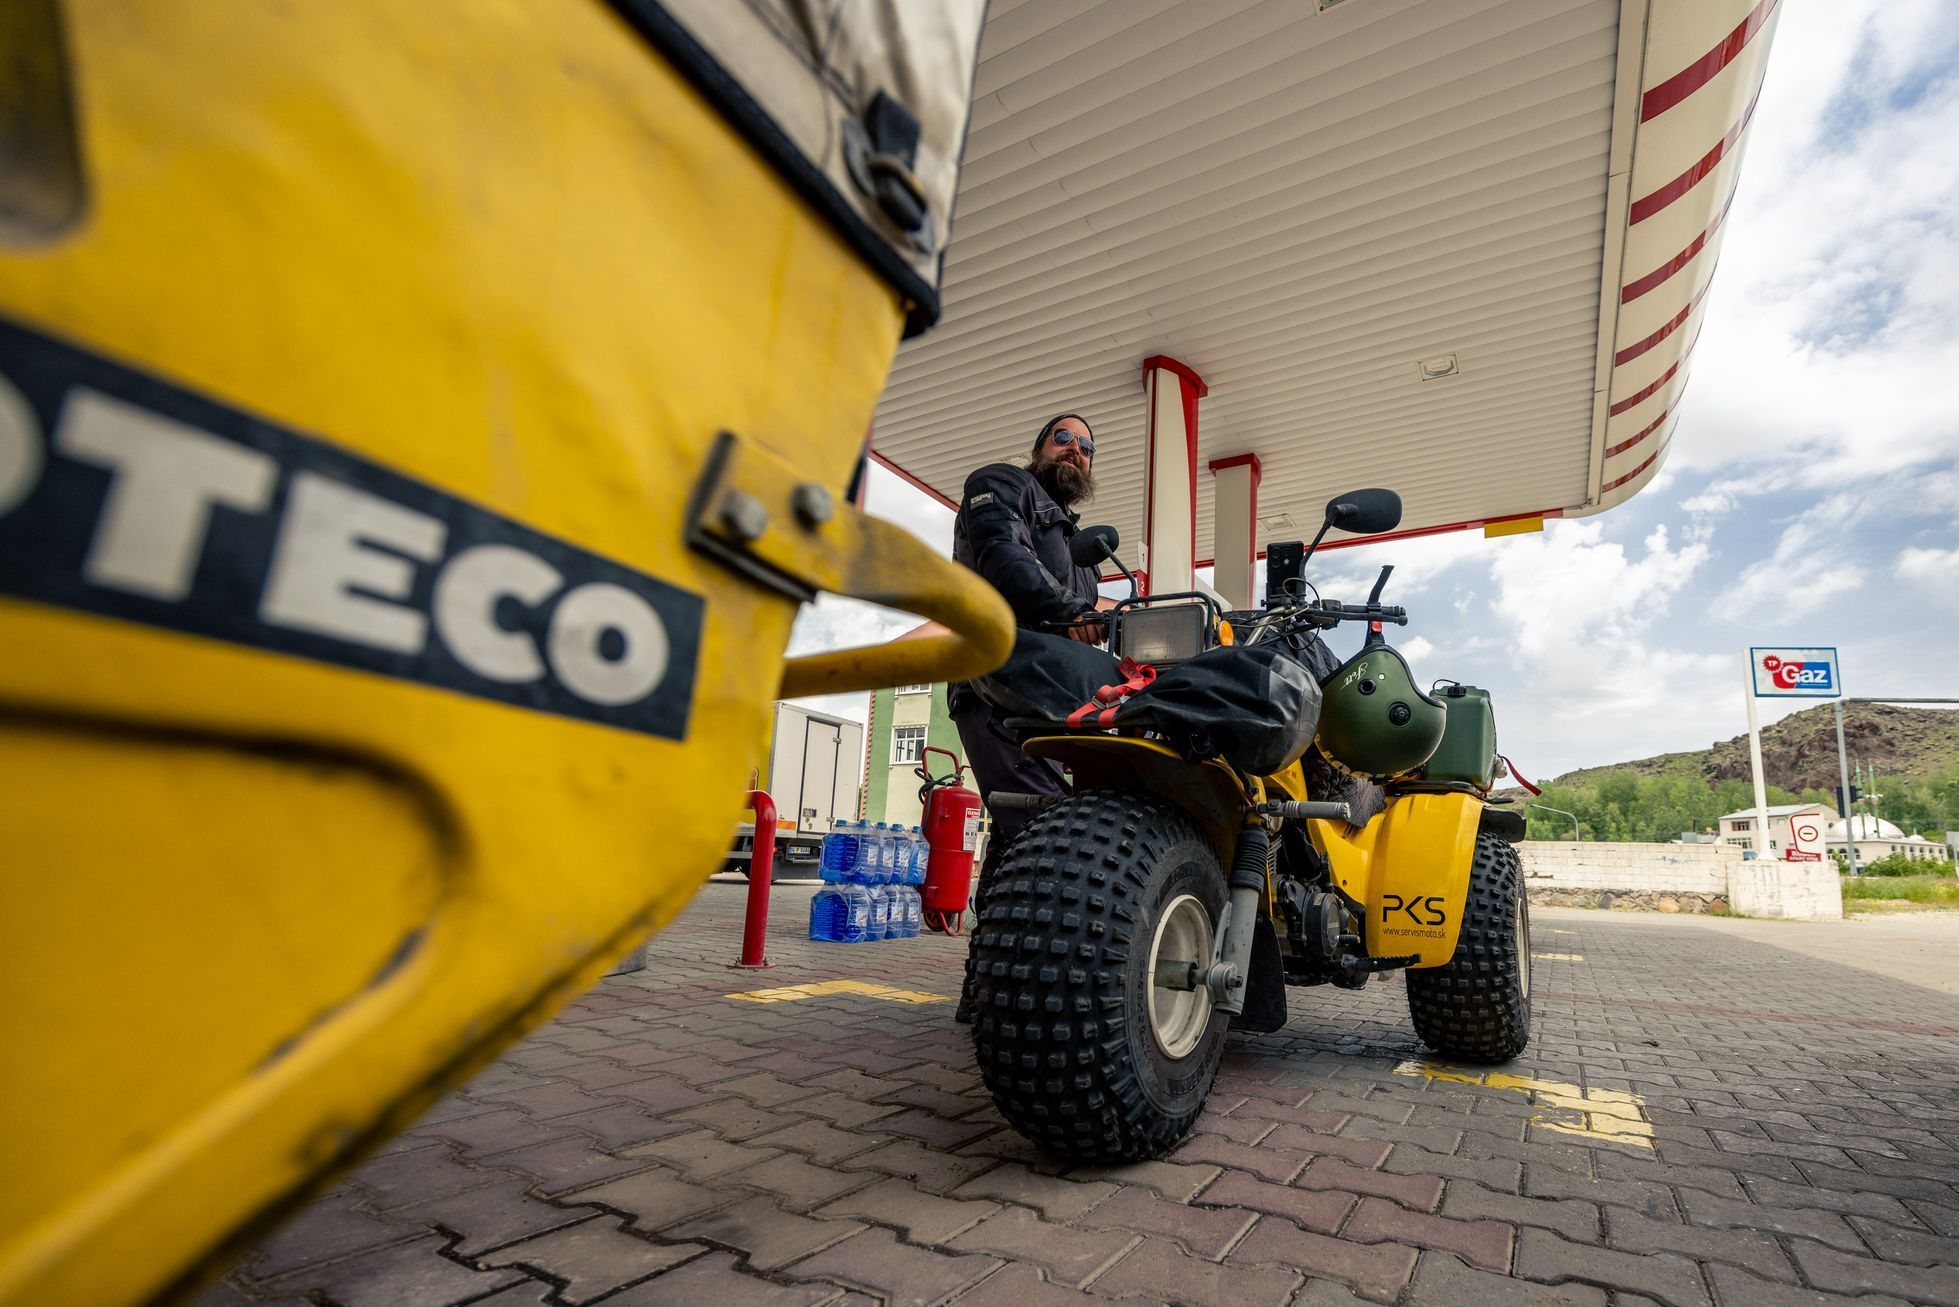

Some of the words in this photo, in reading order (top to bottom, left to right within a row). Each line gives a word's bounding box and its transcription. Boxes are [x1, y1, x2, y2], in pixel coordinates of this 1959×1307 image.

[1140, 581, 1145, 592] 2
[1766, 660, 1778, 668] TP
[1781, 665, 1829, 684] Gaz
[1382, 894, 1446, 926] PKS
[1382, 927, 1447, 939] www.servismoto.sk
